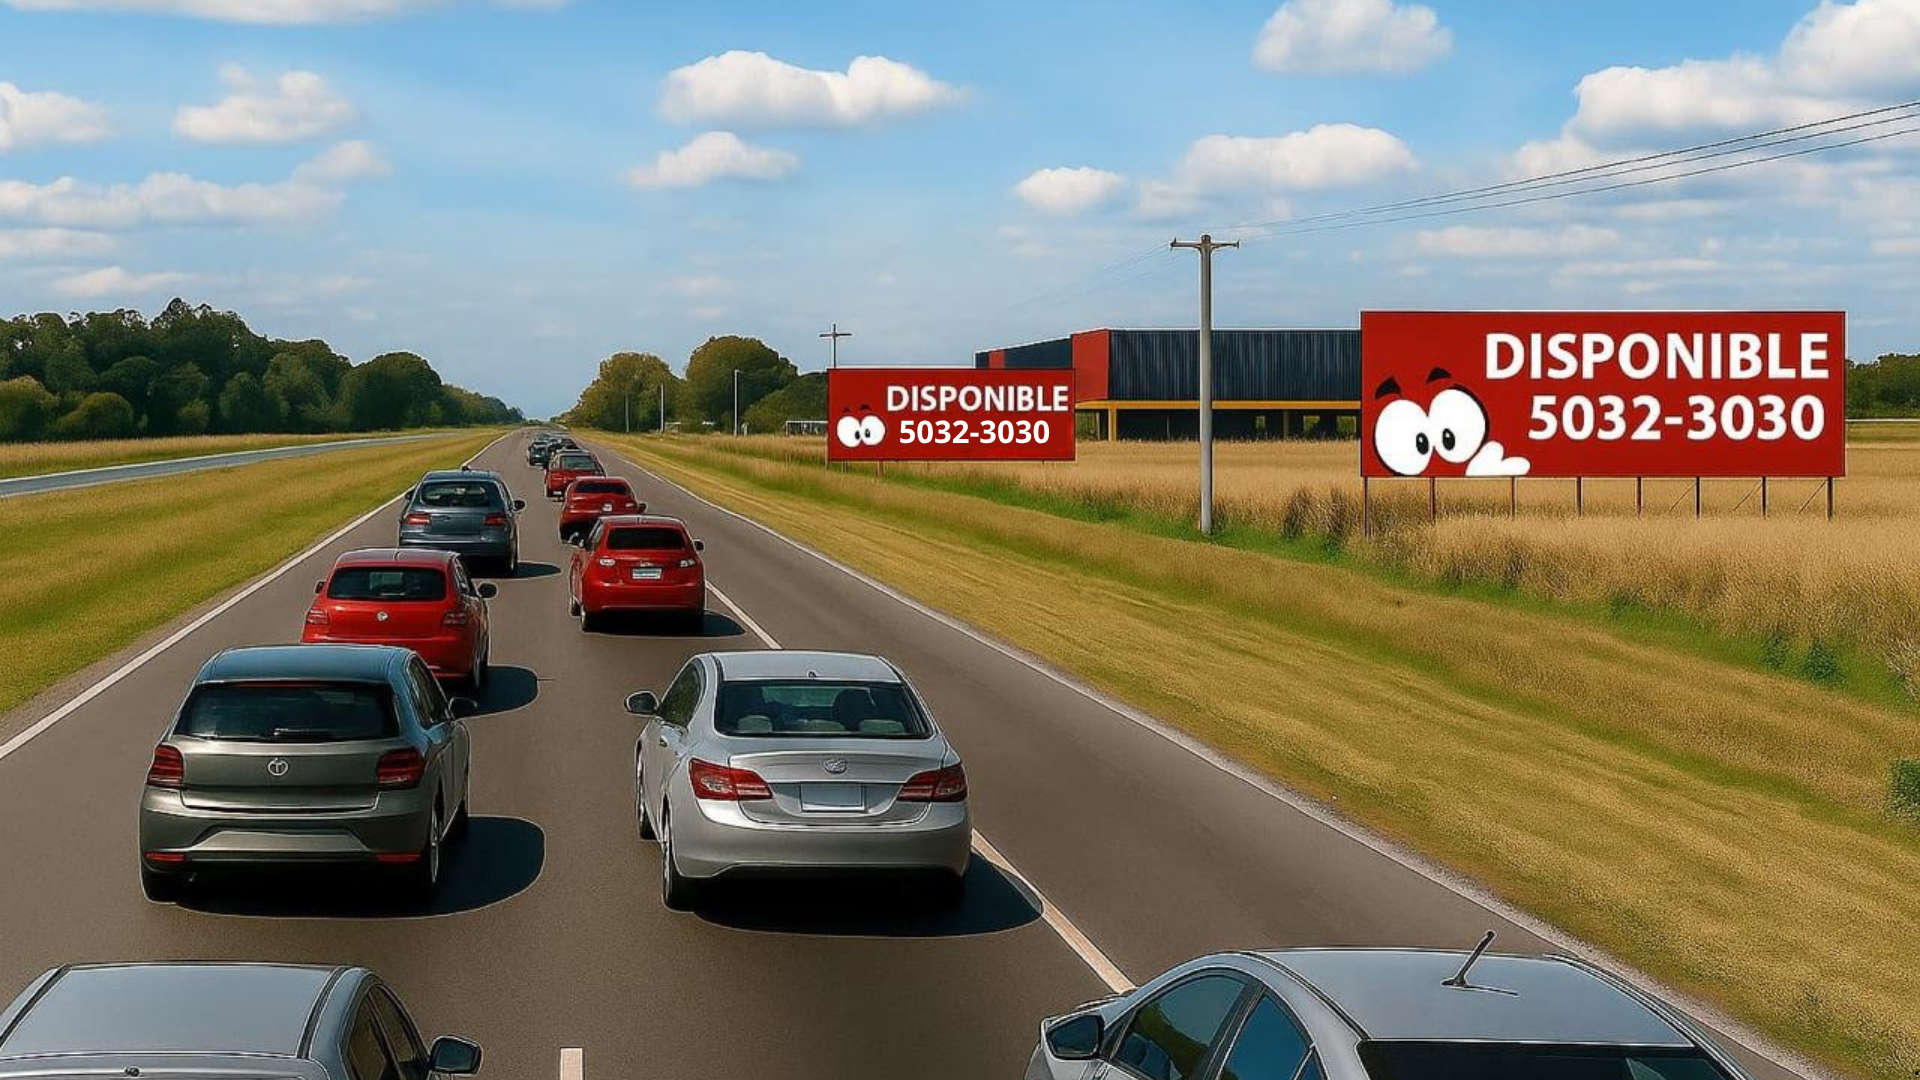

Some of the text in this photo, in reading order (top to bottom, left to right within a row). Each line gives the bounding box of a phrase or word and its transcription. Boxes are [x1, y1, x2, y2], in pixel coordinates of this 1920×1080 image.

[1486, 332, 1829, 380] DISPONIBLE
[886, 385, 1069, 412] DISPONIBLE
[899, 419, 1050, 444] 5032-3030
[1528, 394, 1825, 440] 5032-3030
